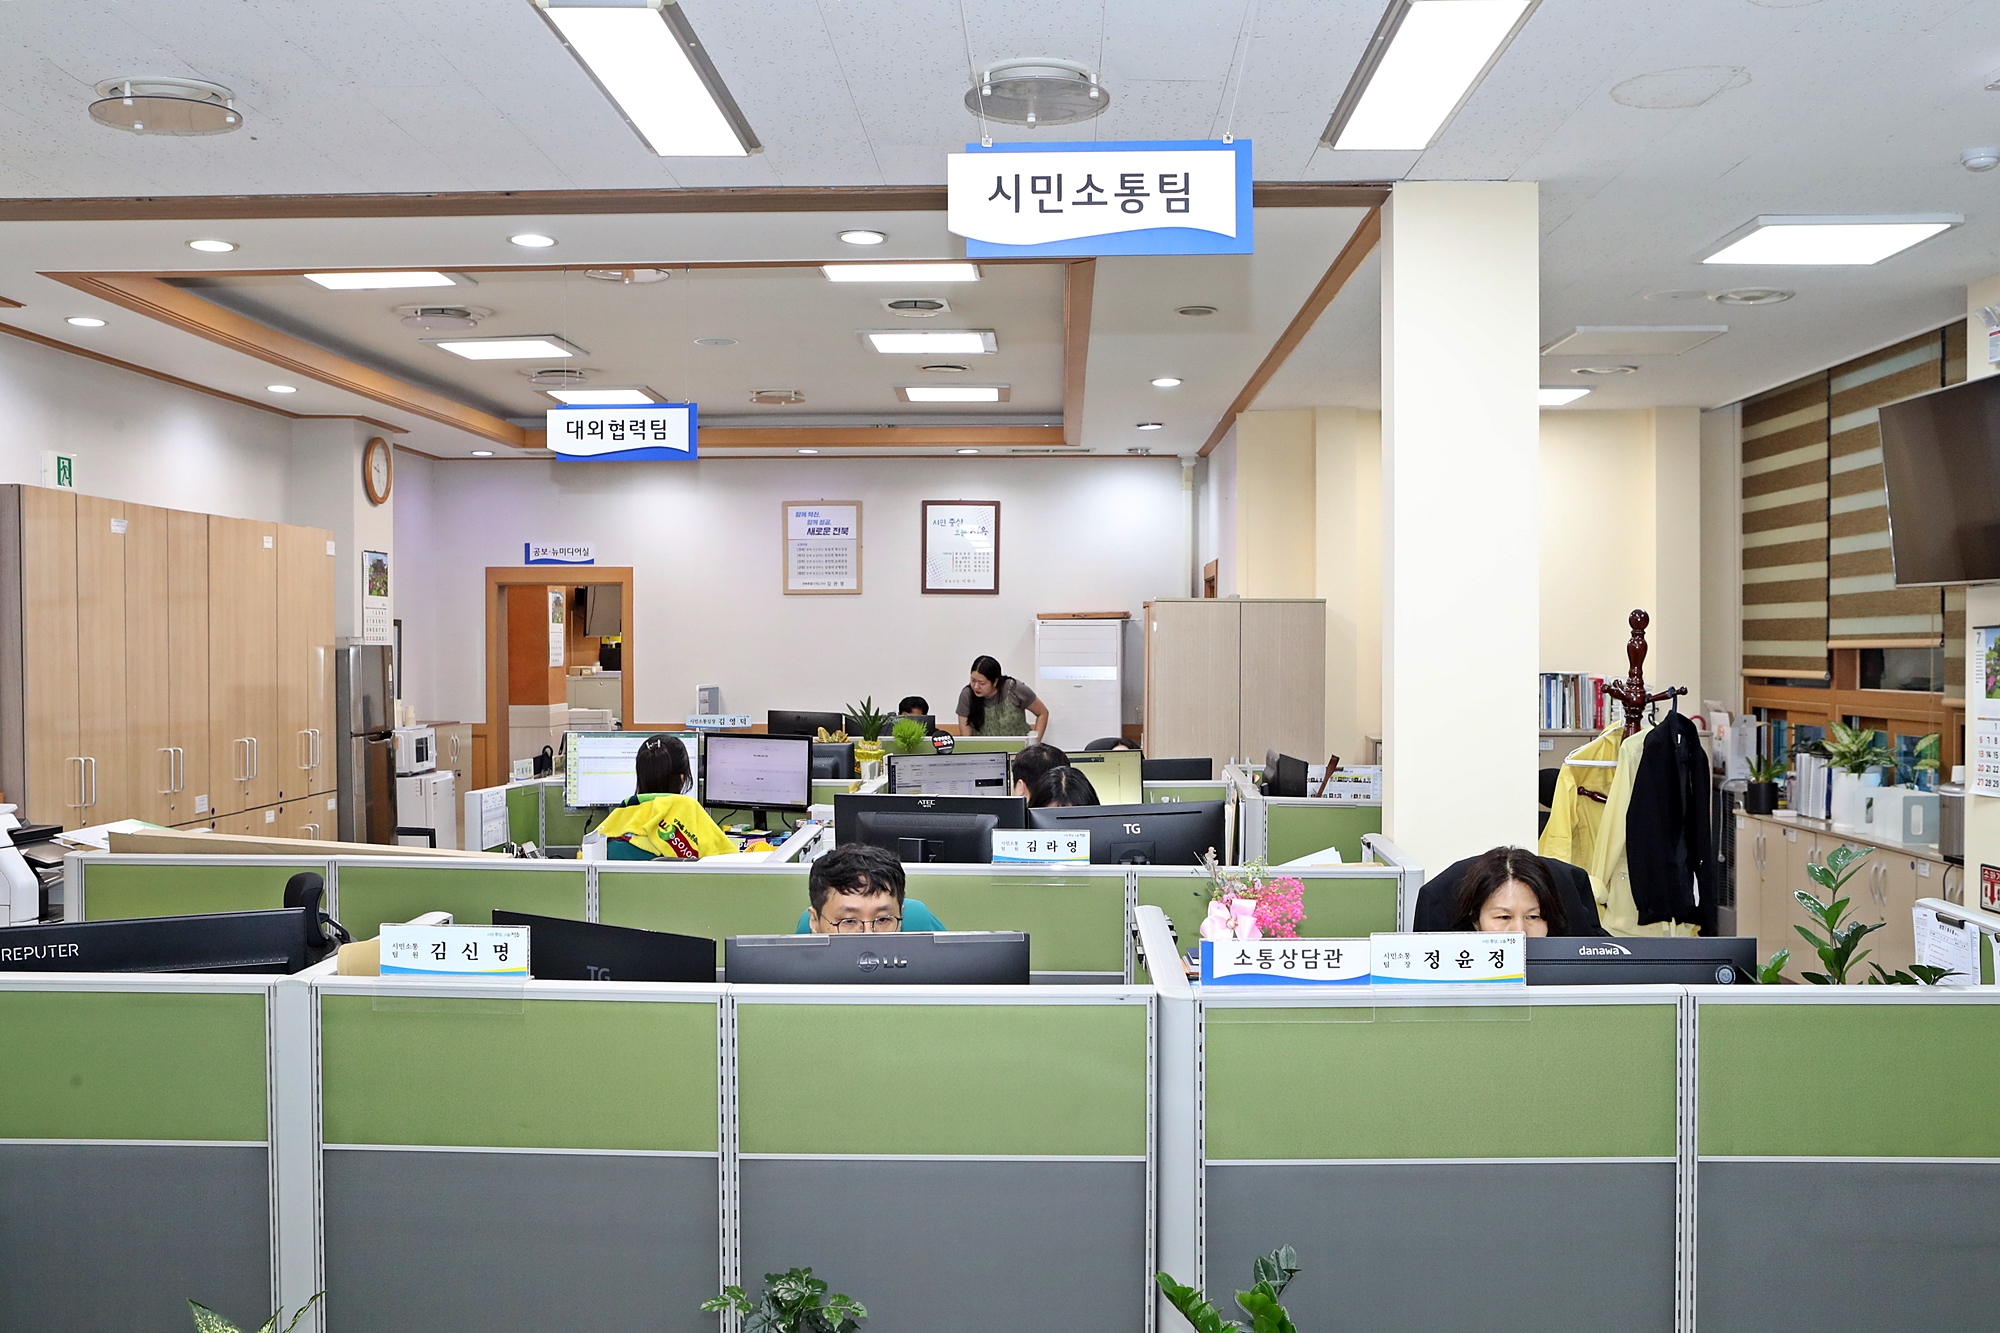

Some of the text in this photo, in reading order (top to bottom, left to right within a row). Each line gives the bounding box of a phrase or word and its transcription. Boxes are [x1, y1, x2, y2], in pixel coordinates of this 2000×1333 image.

[988, 172, 1190, 214] 시민소통팀
[566, 419, 666, 441] 대외협력팀
[806, 527, 849, 536] 새로운 전북
[1976, 632, 1981, 644] 7
[1122, 823, 1141, 835] TG
[1, 943, 80, 962] REPUTER
[391, 942, 419, 951] 시민소통
[1578, 945, 1620, 956] danawa
[1233, 948, 1344, 970] 소통상담관
[1383, 951, 1411, 960] 시민소통
[586, 965, 611, 981] TG
